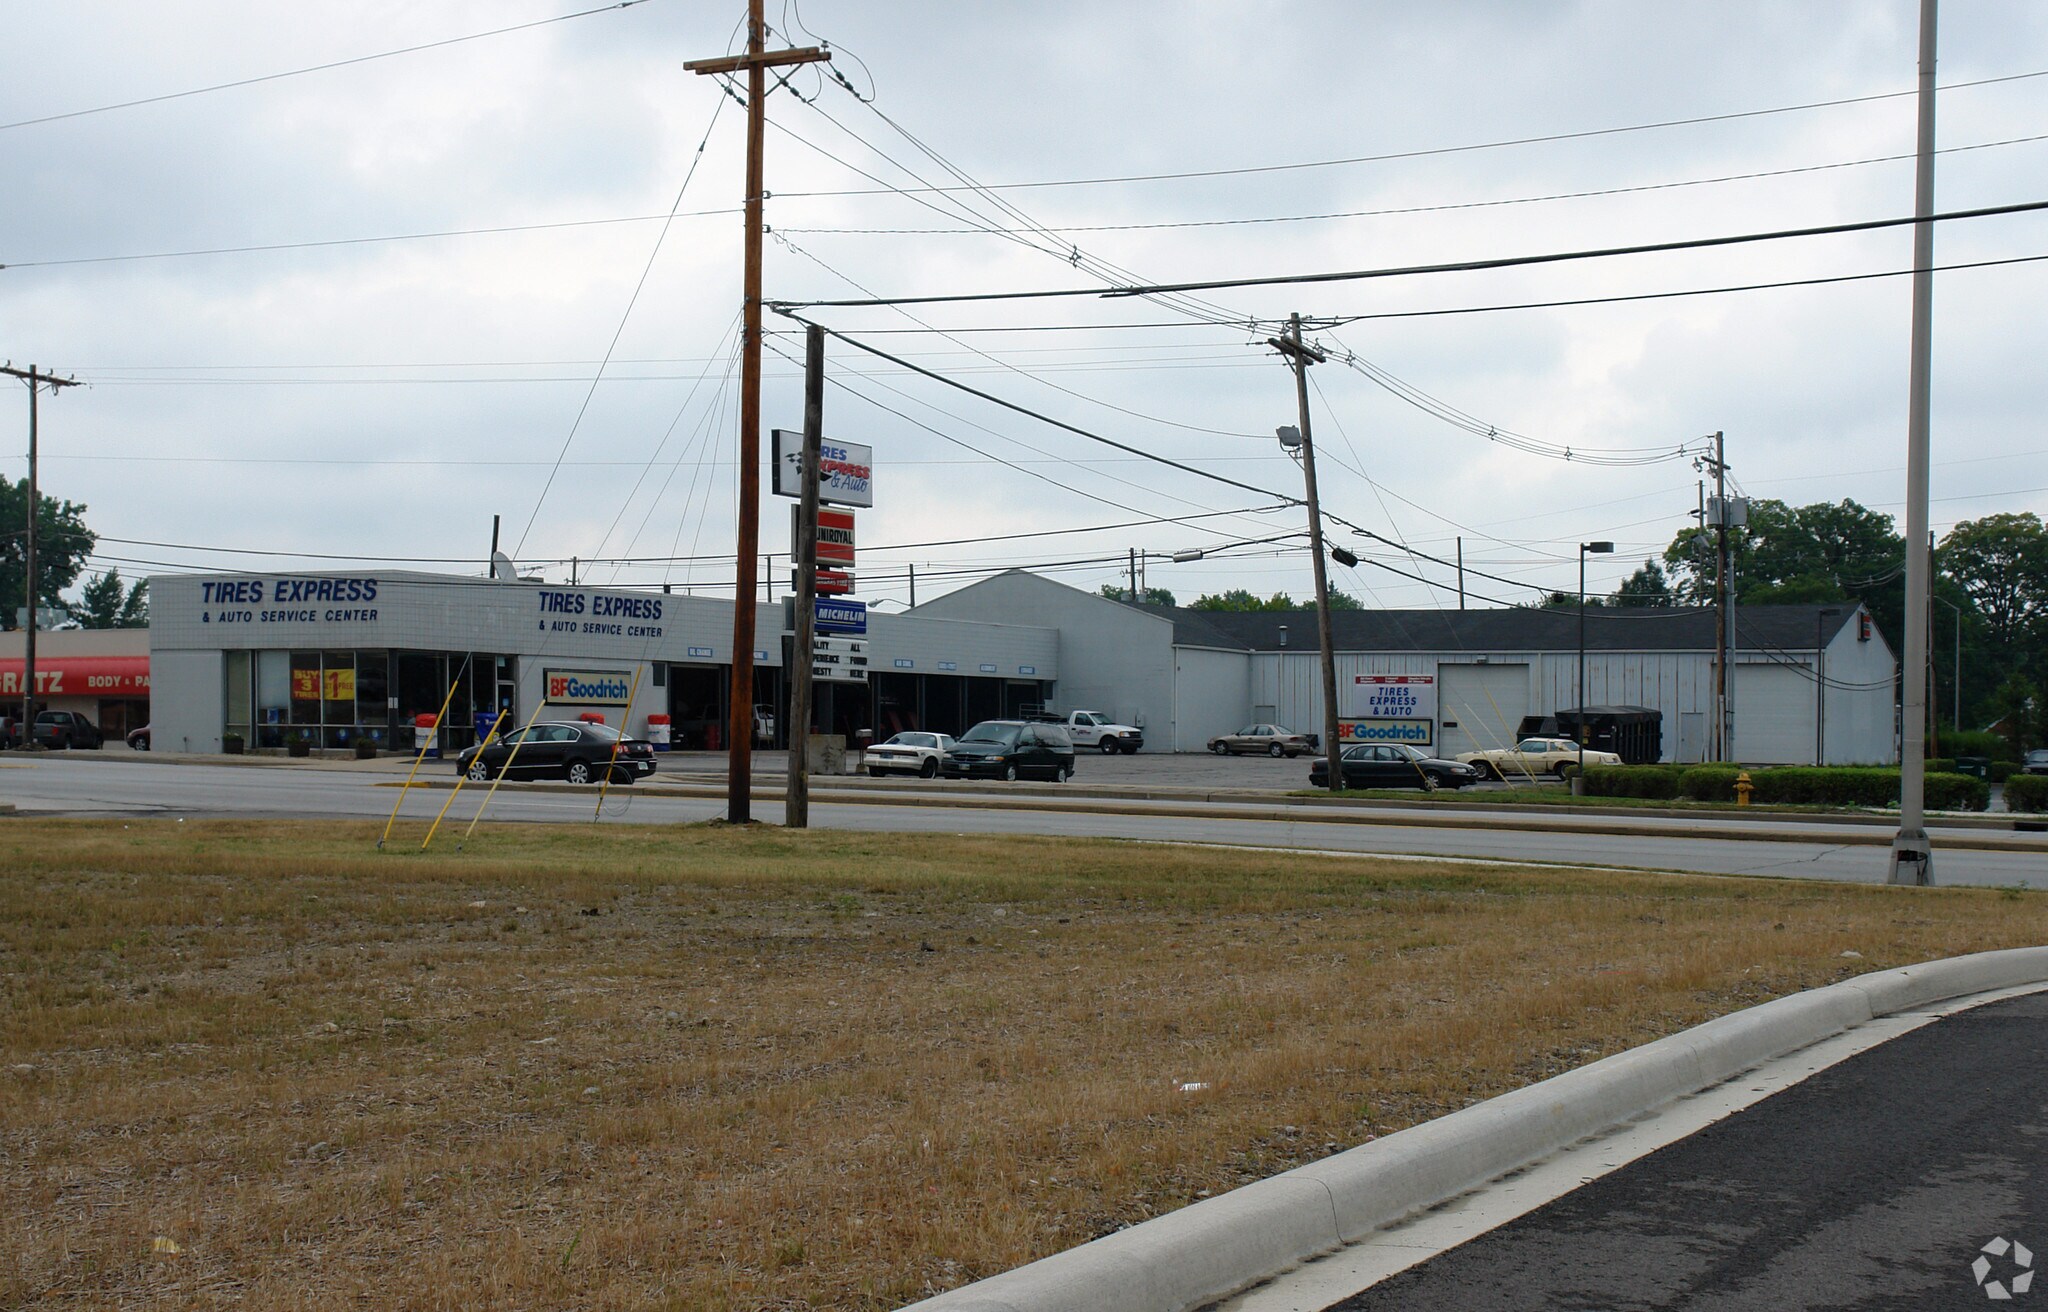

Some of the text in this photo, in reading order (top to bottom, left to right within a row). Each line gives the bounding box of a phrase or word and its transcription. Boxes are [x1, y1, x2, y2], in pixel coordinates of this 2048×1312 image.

[820, 446, 847, 460] RES
[819, 459, 870, 480] XPRESS
[841, 475, 868, 493] Auto
[202, 578, 378, 603] TIRES EXPRESS
[539, 591, 662, 620] TIRES EXPRESS
[202, 609, 378, 622] & AUTO SERVICE CENTER
[818, 608, 866, 622] MICHELIN
[539, 620, 662, 637] & AUTO SERVICE CENTER
[0, 671, 64, 693] RTZ
[88, 676, 122, 687] BODY
[135, 675, 150, 687] PA
[294, 670, 319, 679] BUY
[301, 680, 313, 691] 3
[328, 672, 339, 698] 1
[550, 677, 628, 699] BFGoodrich
[1378, 687, 1409, 696] TIRES
[1369, 696, 1417, 705] EXPRESS
[1373, 707, 1412, 715] & AUTO
[1337, 723, 1426, 740] BFGoodrich
